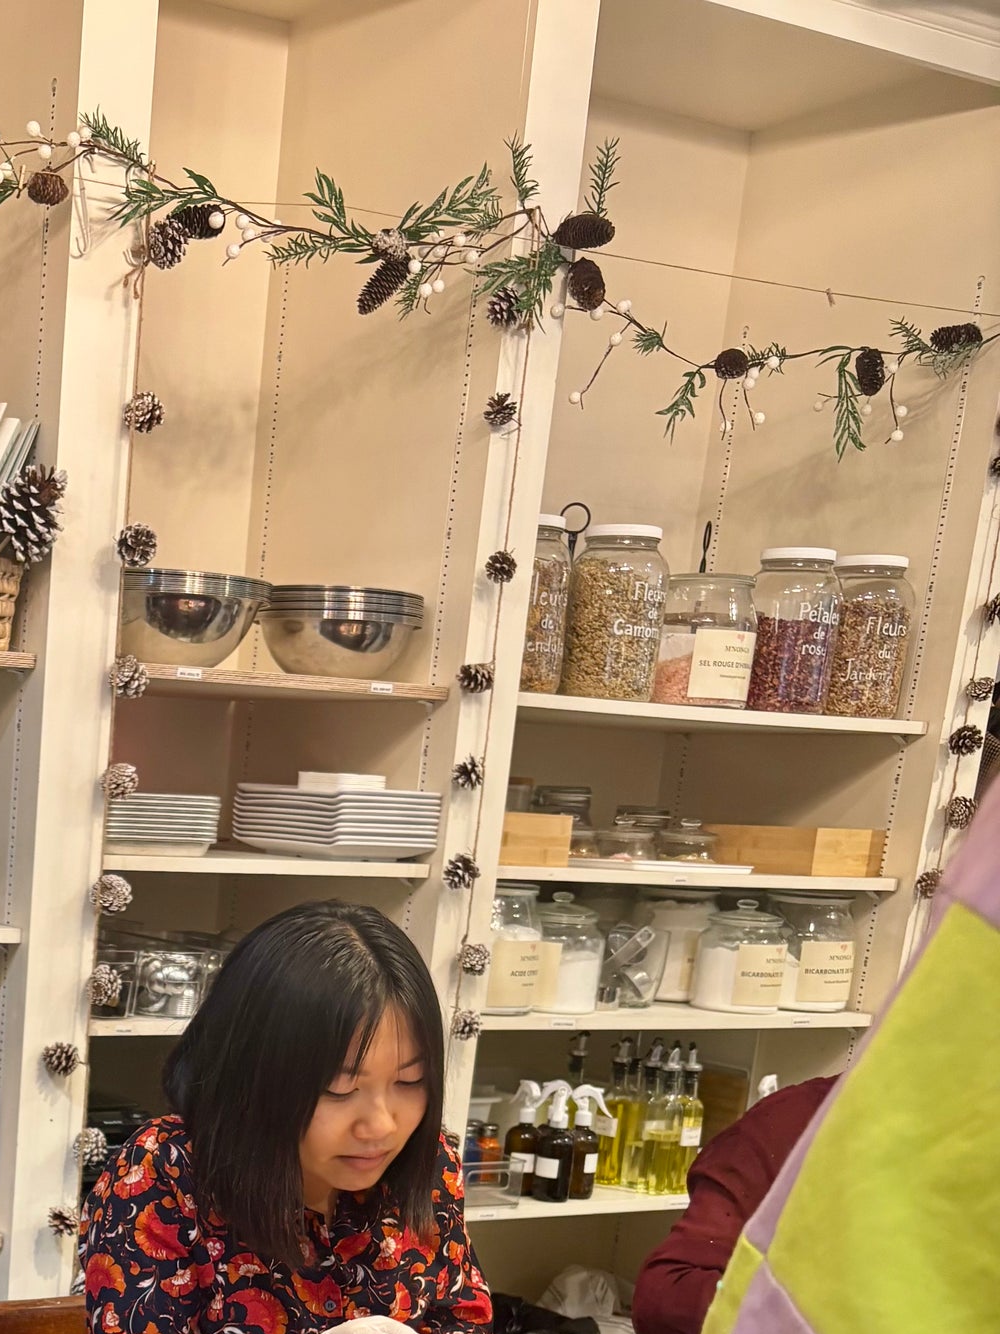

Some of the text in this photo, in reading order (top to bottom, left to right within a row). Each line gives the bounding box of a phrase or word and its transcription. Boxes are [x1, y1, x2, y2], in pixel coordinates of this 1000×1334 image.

[533, 571, 568, 607] leurs
[813, 626, 826, 640] de
[866, 616, 907, 637] Fleurs
[878, 644, 891, 659] du
[698, 659, 711, 668] SEL
[712, 660, 734, 669] ROUGE
[840, 658, 888, 682] Jardin
